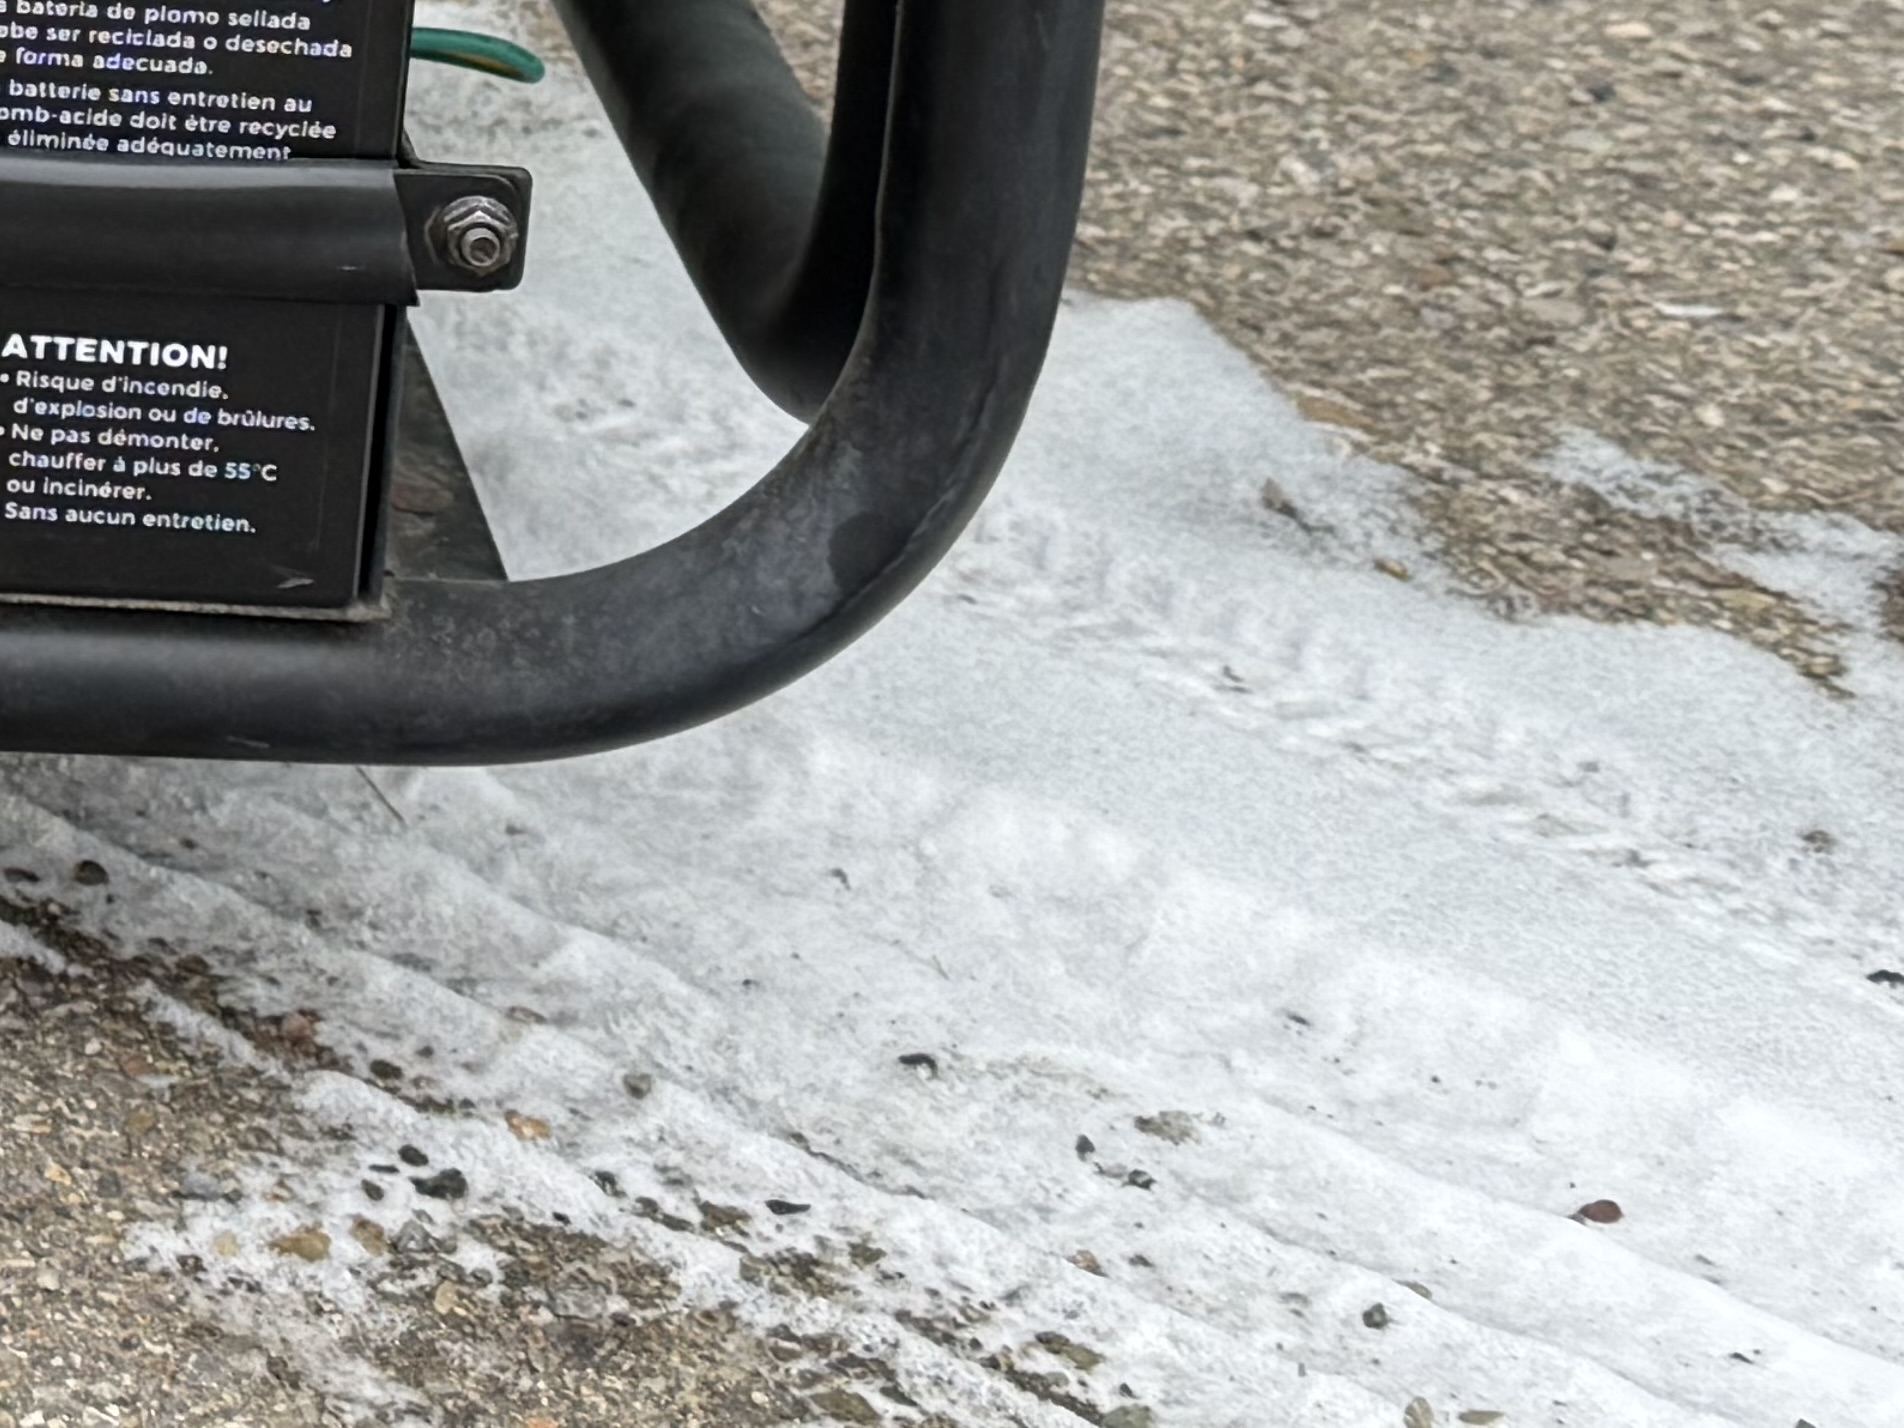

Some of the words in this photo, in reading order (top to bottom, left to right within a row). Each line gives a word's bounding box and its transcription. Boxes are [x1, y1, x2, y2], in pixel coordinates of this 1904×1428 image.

[1, 333, 227, 370] ATTENTION!
[16, 370, 94, 393] Risque
[13, 397, 142, 420] d'explosion
[148, 407, 176, 422] ou
[183, 407, 212, 424] de
[217, 408, 315, 431] brûlures.
[11, 422, 44, 441] Ne
[50, 428, 90, 445] pas
[8, 450, 106, 471] chauffer
[112, 455, 126, 472] à
[133, 456, 181, 477] plus
[188, 459, 218, 478] de
[224, 462, 277, 481] 55°C
[6, 478, 35, 493] ou
[43, 477, 151, 500] incinérer.
[4, 501, 58, 521] Sans
[64, 508, 135, 525] aucun
[142, 512, 255, 533] entretien.
